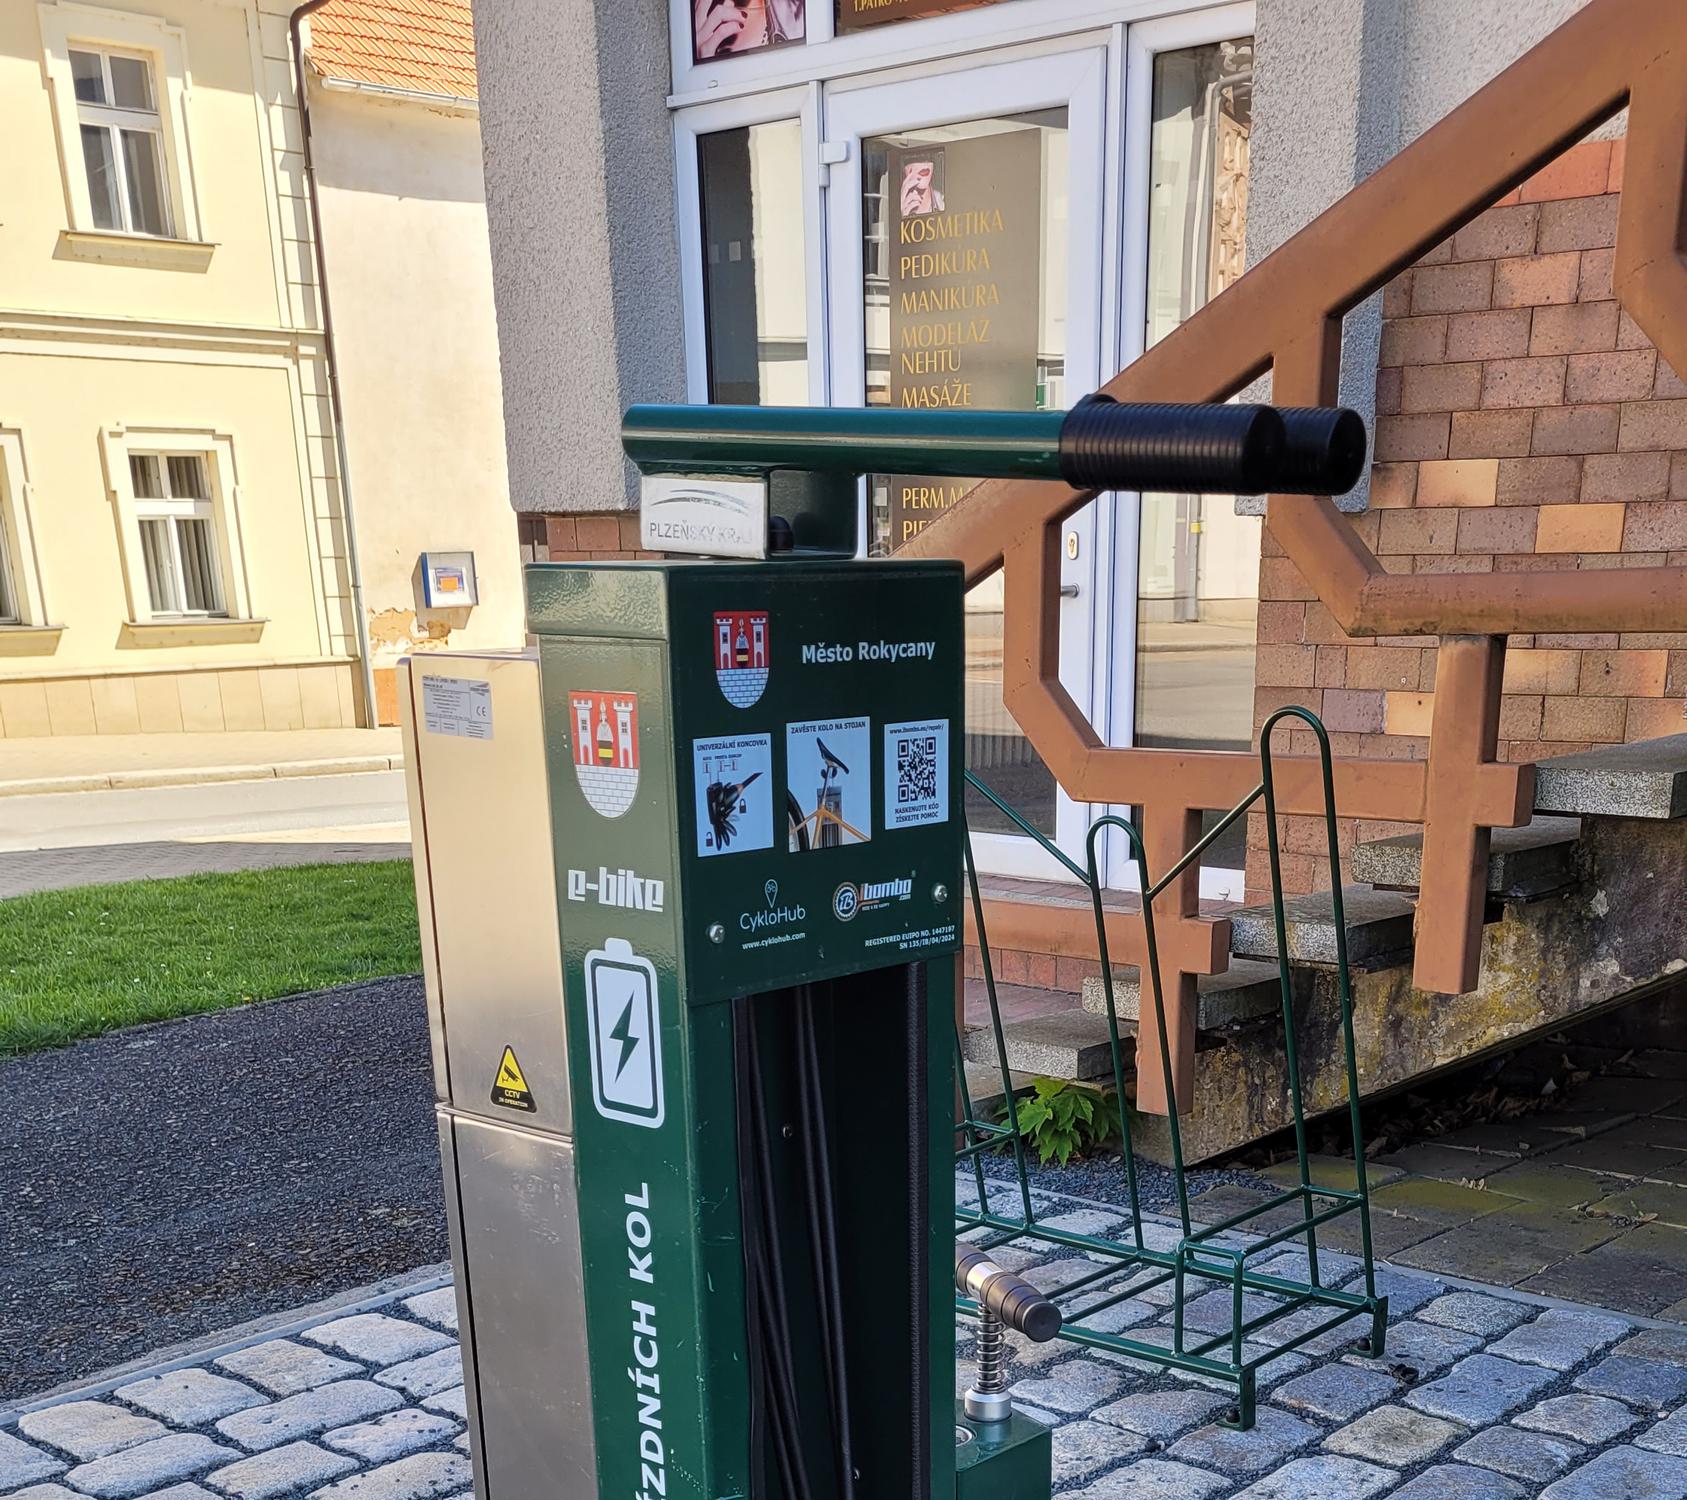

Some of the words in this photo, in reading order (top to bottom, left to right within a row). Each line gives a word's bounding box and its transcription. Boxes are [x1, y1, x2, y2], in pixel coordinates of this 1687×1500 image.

[900, 208, 1004, 245] KOSMETIKA
[900, 377, 972, 408] MASÁŽE
[802, 641, 853, 664] Město
[858, 640, 936, 663] Rokycany
[818, 723, 834, 732] KOLO
[835, 722, 843, 730] NA
[844, 721, 866, 730] STOJAN
[736, 738, 768, 748] KONCOVKA
[920, 811, 939, 820] POMOC
[567, 866, 664, 913] e-bike
[860, 878, 913, 901] ibombo
[740, 904, 806, 933] CykloHub
[741, 932, 806, 950] www.cyklohub.com
[864, 934, 901, 948] REGISTERED
[901, 931, 920, 941] EUIPO
[899, 941, 908, 950] SN
[504, 1089, 521, 1099] CCTV
[624, 1182, 654, 1284] KOL
